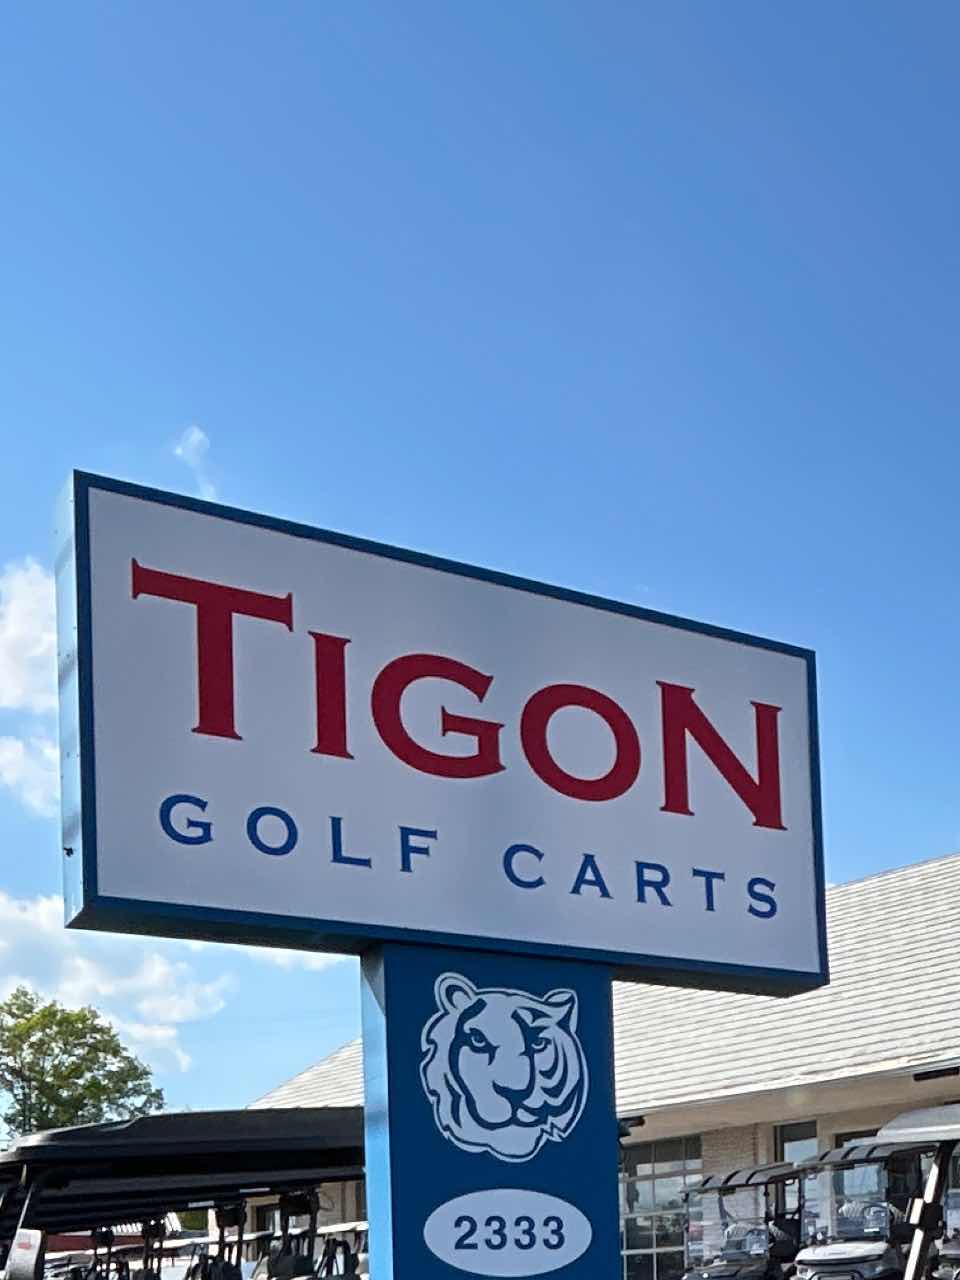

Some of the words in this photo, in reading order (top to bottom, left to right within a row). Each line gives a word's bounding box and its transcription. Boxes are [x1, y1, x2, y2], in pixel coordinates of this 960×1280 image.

[131, 558, 788, 831] TIGON
[158, 793, 439, 873] GOLF
[502, 843, 778, 920] CARTS
[453, 1214, 567, 1251] 2333
